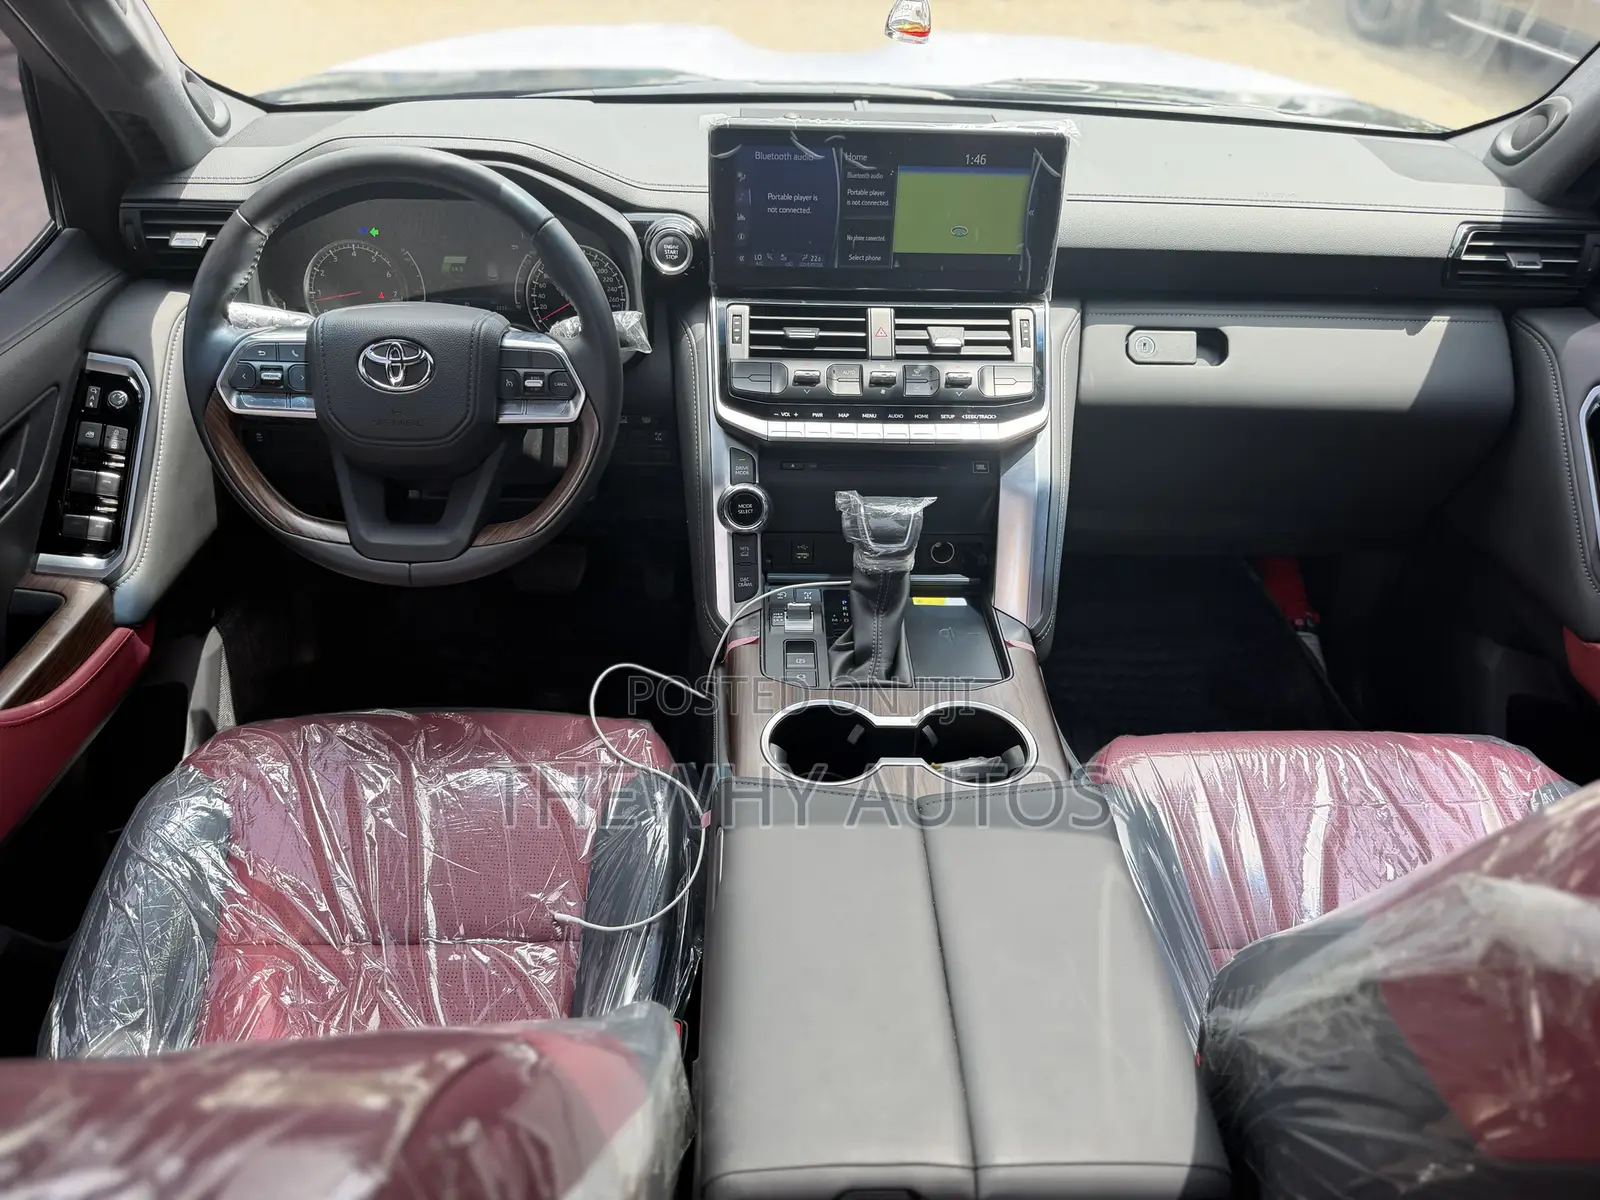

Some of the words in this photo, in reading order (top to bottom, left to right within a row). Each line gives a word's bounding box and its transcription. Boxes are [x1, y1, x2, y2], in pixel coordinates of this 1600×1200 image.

[755, 151, 793, 161] Bluetooth
[794, 151, 814, 161] audio
[845, 152, 868, 161] Home
[965, 153, 987, 165] 1:46
[847, 171, 870, 179] Bluetooth
[847, 188, 869, 196] Portable
[869, 189, 886, 197] player
[767, 192, 793, 201] Portable
[793, 193, 812, 202] player
[767, 206, 778, 214] not
[779, 206, 812, 214] connected.
[853, 234, 865, 242] phone
[333, 255, 338, 263] 3
[371, 255, 377, 263] 5
[754, 253, 763, 261] LO
[848, 253, 864, 261] Select
[864, 254, 882, 262] phone
[320, 269, 325, 277] 2
